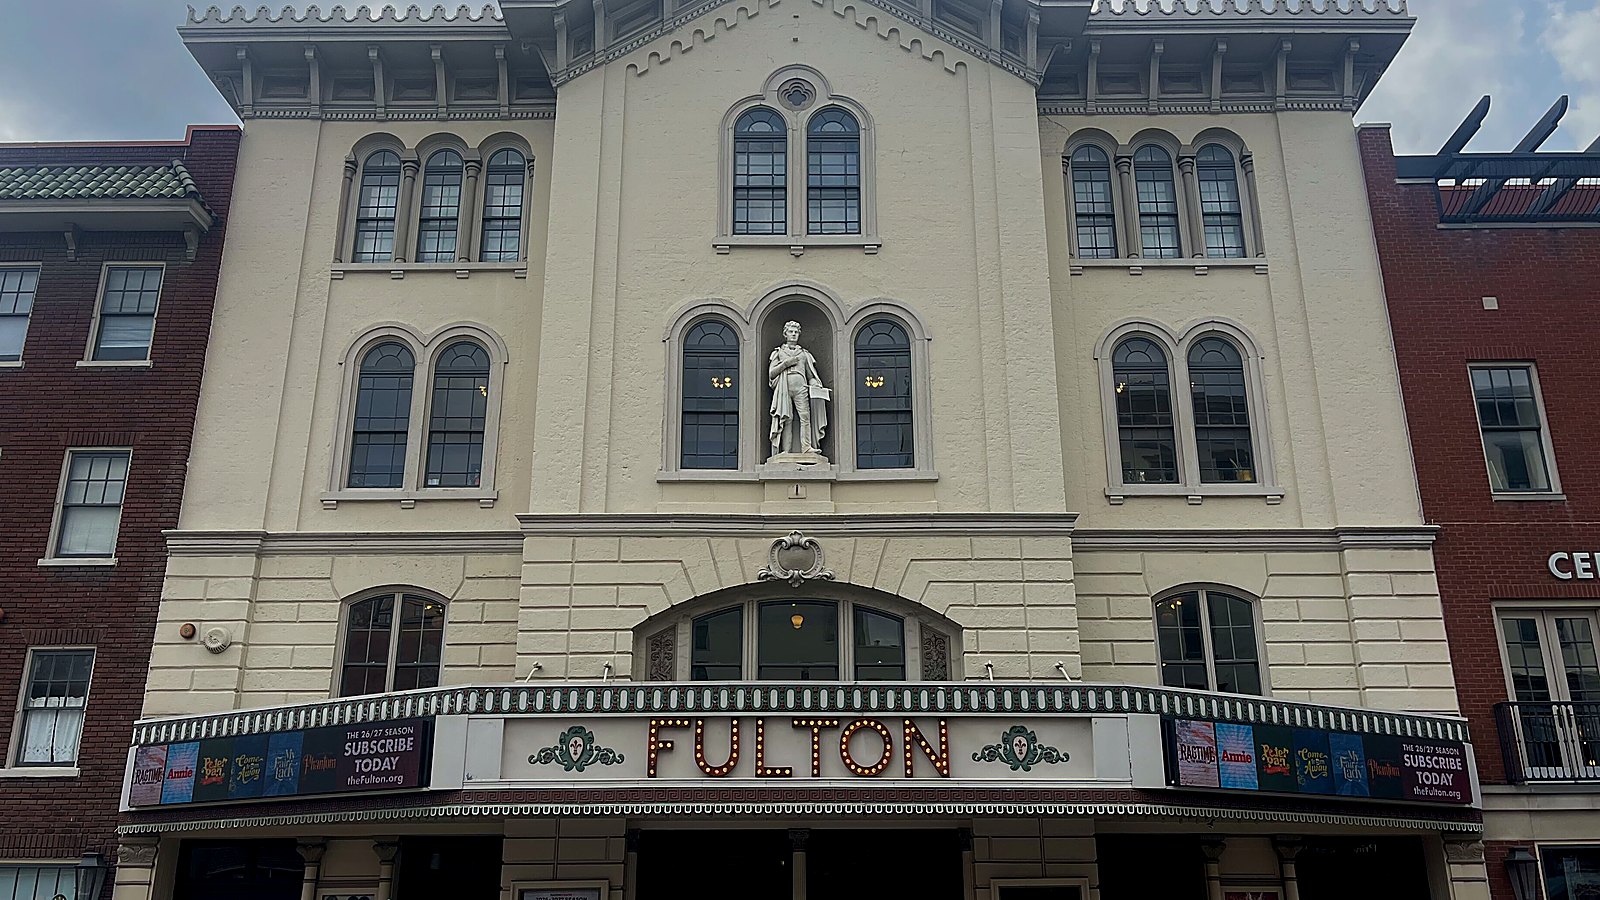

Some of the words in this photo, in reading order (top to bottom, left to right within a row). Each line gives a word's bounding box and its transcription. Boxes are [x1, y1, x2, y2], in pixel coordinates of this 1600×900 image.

[1548, 551, 1600, 579] CE
[347, 731, 360, 740] THE
[361, 729, 383, 739] 26/27
[384, 726, 414, 737] SEASON
[344, 737, 414, 756] SUBSCRIBE
[647, 717, 950, 778] FULTON
[1260, 744, 1289, 758] Peter
[1402, 743, 1414, 752] THE
[1415, 744, 1434, 753] 26/27
[1435, 747, 1460, 755] SEASON
[235, 754, 263, 767] Come
[1179, 744, 1215, 764] RAGTIME
[1221, 750, 1252, 763] Annie
[1298, 748, 1328, 760] Come
[303, 754, 337, 774] Phantom
[354, 756, 400, 773] TODAY
[1403, 754, 1462, 770] SUBSCRIBE
[166, 766, 193, 780] Annie
[347, 774, 404, 786] theFulton.org
[1416, 771, 1454, 786] TODAY
[1413, 785, 1461, 799] theFulton.org
